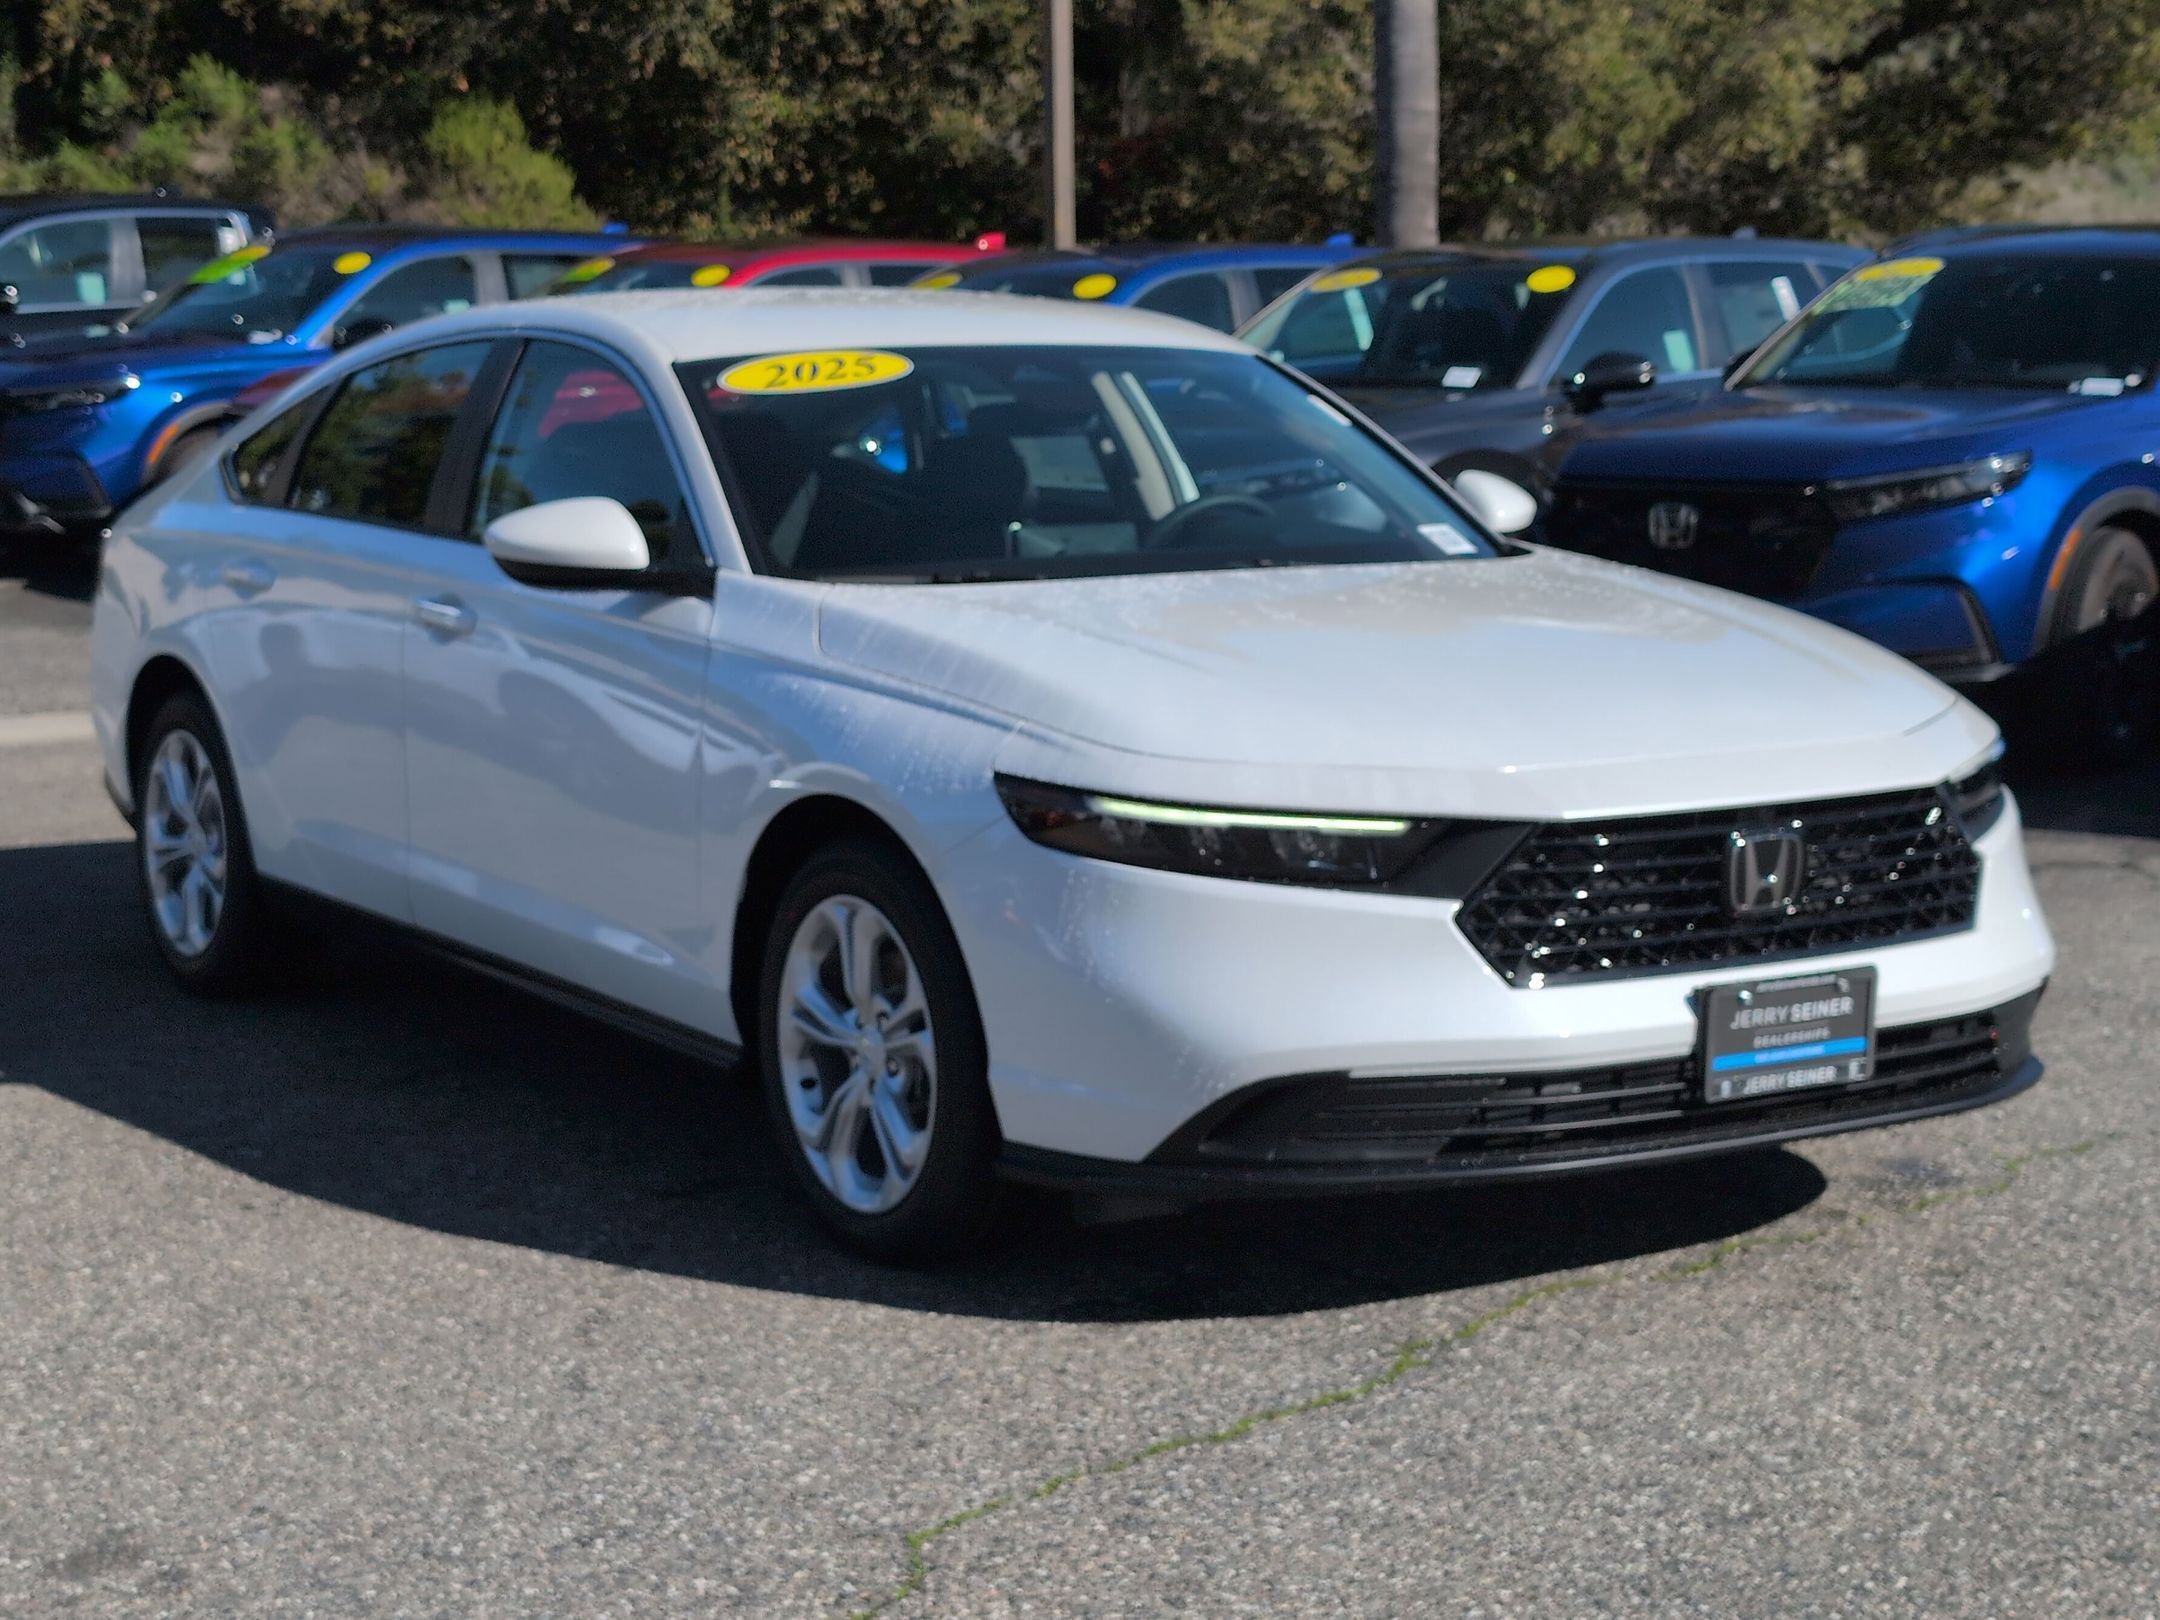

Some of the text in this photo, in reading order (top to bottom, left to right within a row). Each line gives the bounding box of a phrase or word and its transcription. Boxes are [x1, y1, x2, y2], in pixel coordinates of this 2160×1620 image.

[763, 355, 876, 388] 2025
[1730, 996, 1854, 1030] JERRY SEINER
[1743, 1066, 1838, 1095] JERRY SEINER
